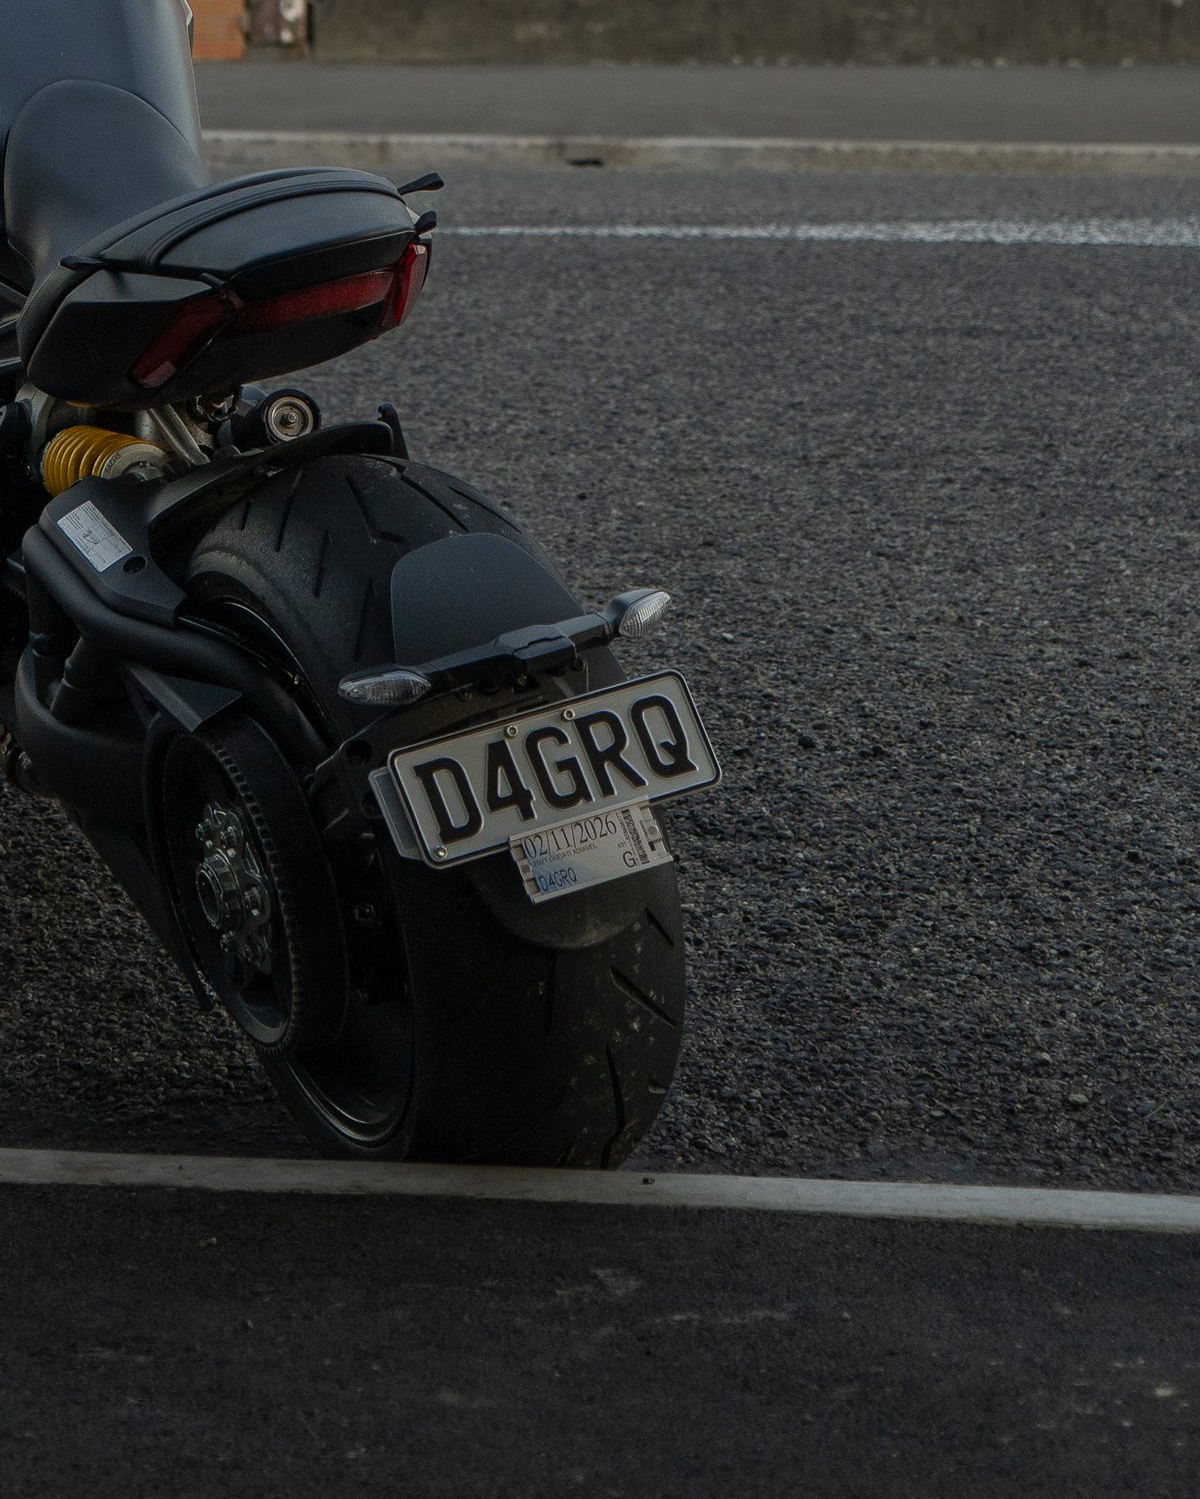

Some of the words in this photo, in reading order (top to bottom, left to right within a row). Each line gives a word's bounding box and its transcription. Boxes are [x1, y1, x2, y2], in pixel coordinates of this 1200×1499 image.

[413, 694, 699, 844] D4GRQ
[523, 812, 617, 859] 02/11/2026
[622, 851, 637, 868] G
[538, 866, 578, 892] D4GRQ
